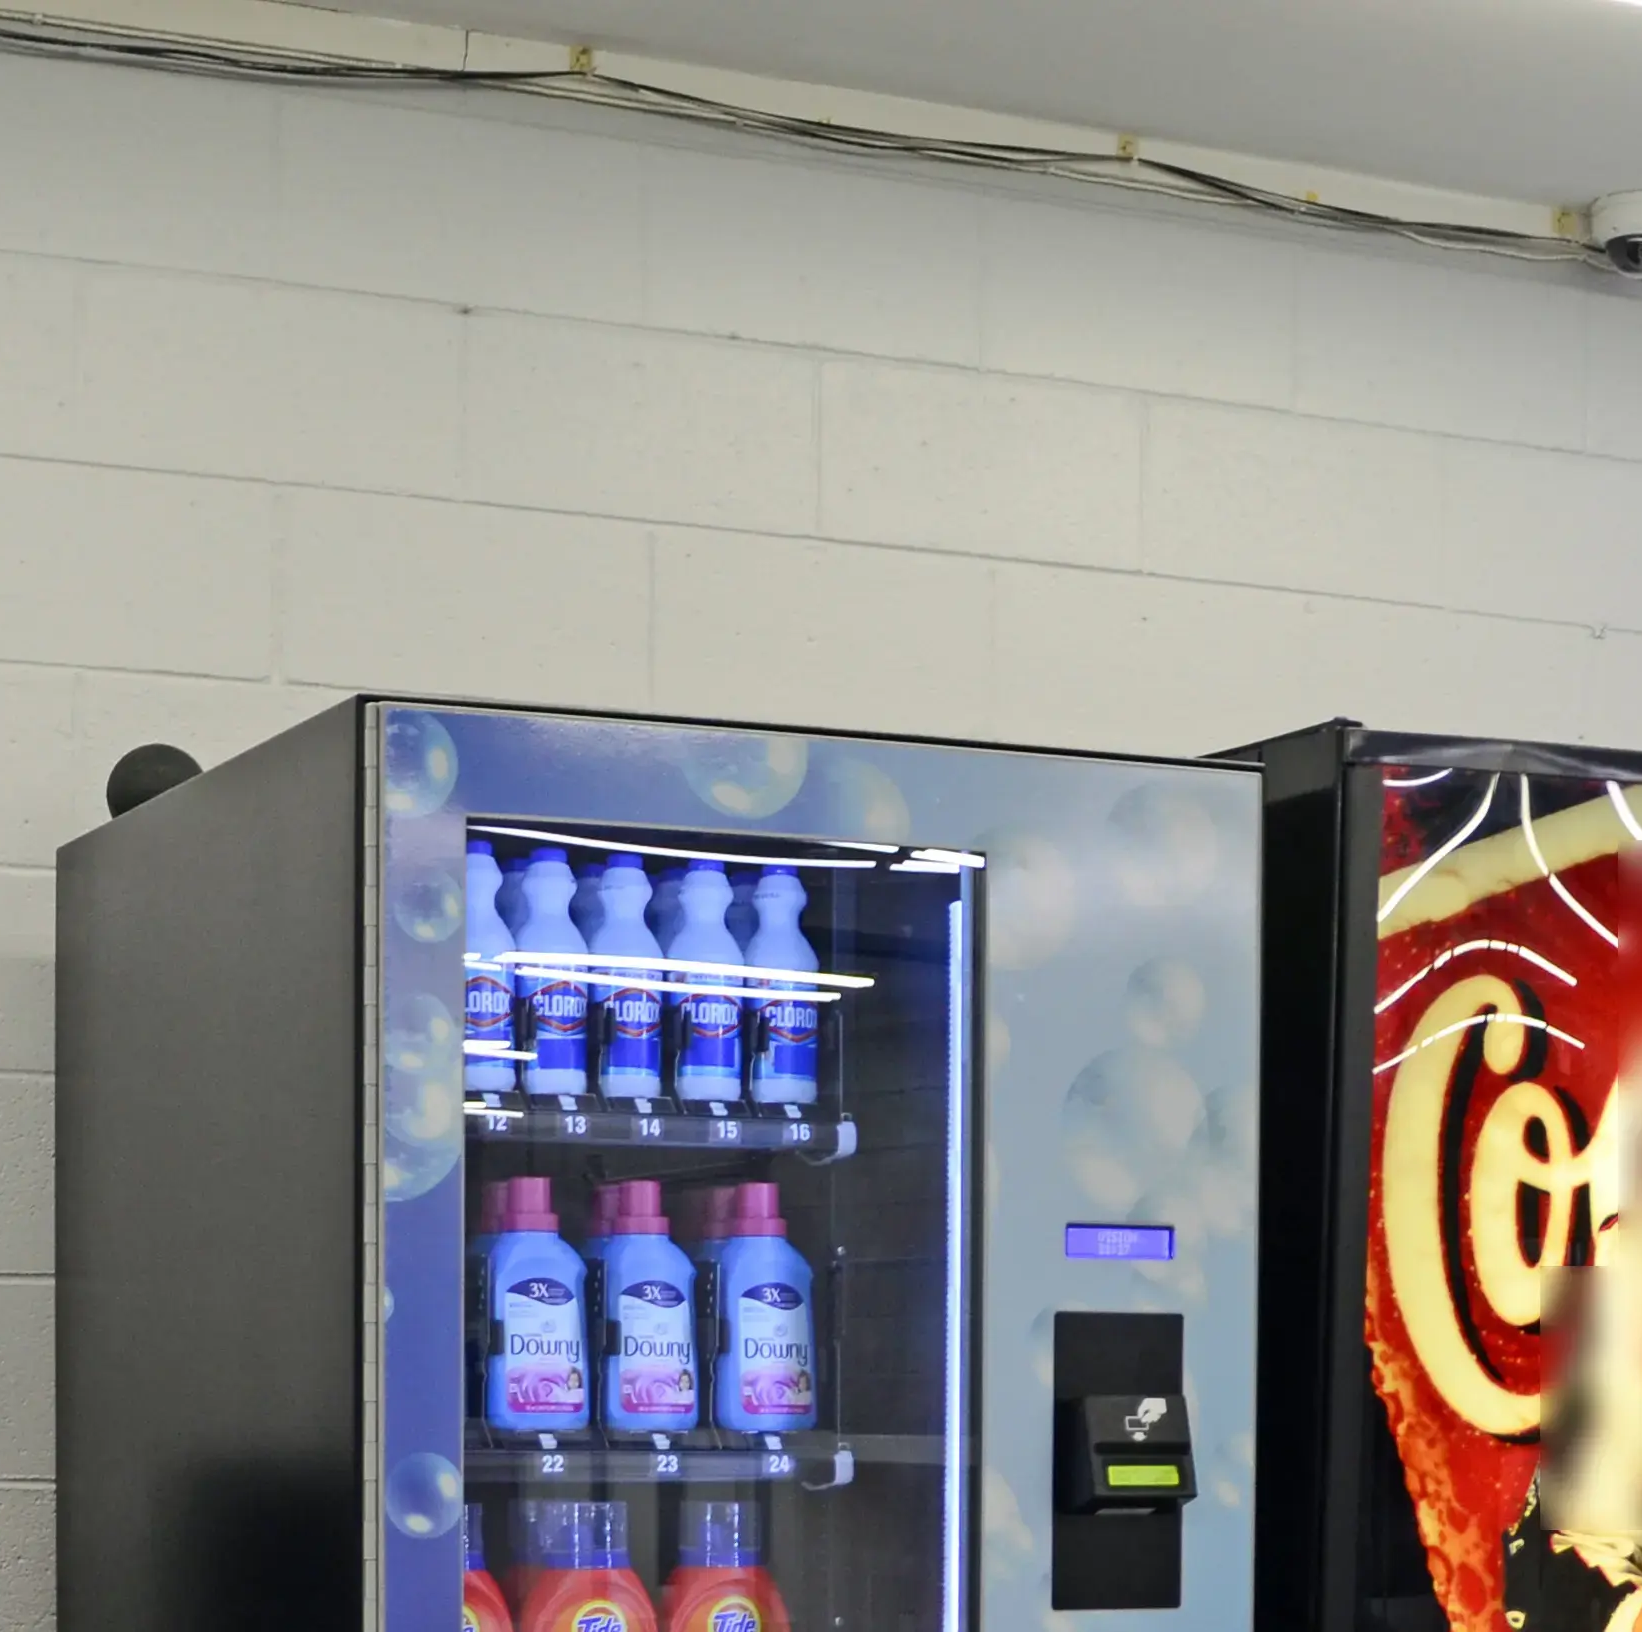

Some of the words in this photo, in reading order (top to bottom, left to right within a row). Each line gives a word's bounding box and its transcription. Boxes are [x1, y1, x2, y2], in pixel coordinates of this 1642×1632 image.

[465, 991, 511, 1014] OROX
[486, 1114, 507, 1131] 12
[564, 1116, 587, 1134] 13
[639, 1119, 661, 1137] 14
[717, 1121, 738, 1139] 15
[790, 1123, 810, 1141] 16
[529, 1282, 549, 1298] 3X
[642, 1285, 662, 1300] 3X
[761, 1287, 781, 1302] 3X
[510, 1334, 581, 1363] Downy
[624, 1335, 691, 1364] Downy
[744, 1337, 808, 1366] Downy
[542, 1455, 564, 1473] 22
[657, 1454, 678, 1472] 23
[769, 1454, 791, 1472] 24
